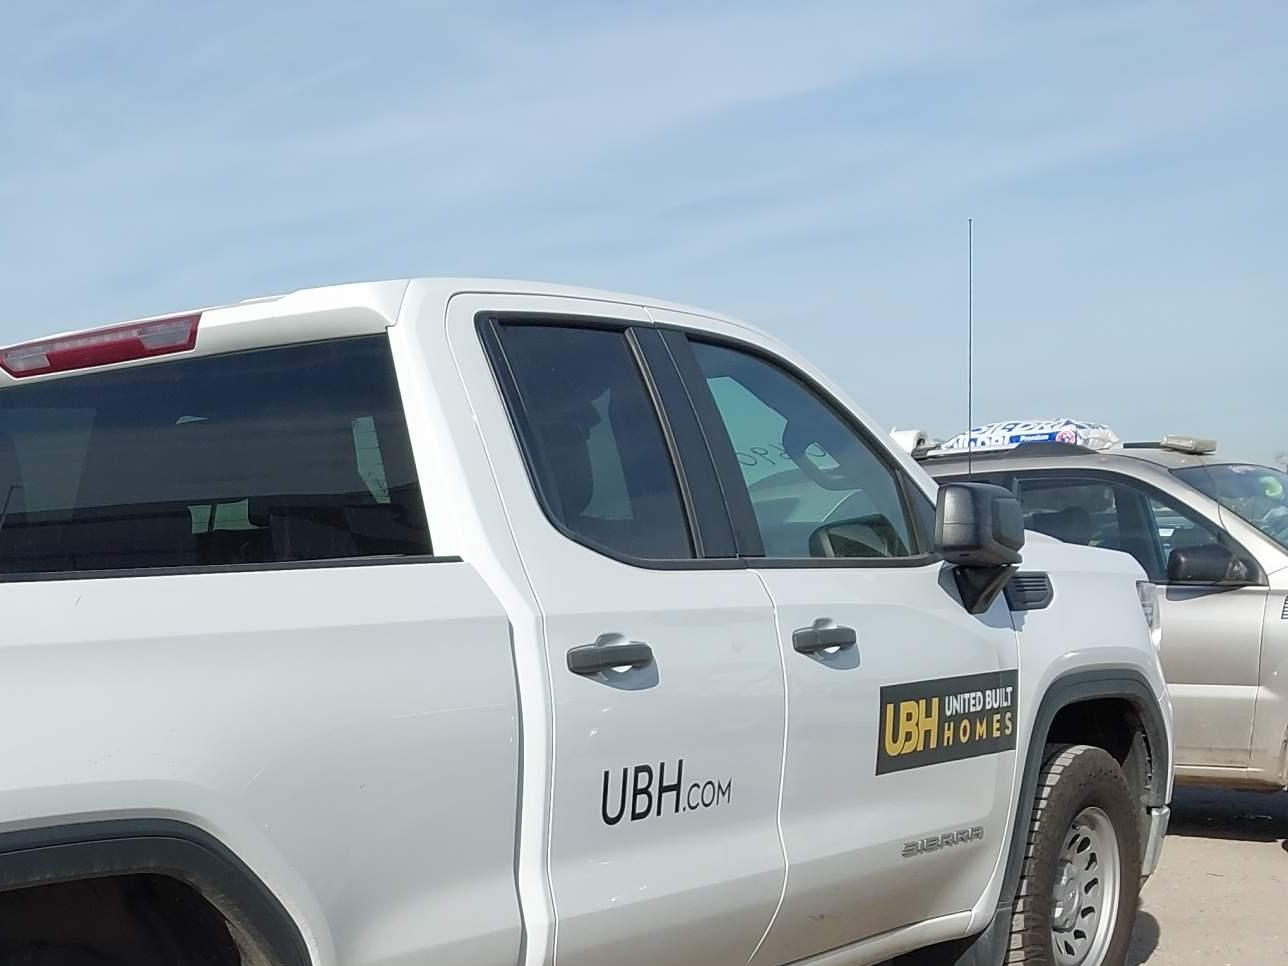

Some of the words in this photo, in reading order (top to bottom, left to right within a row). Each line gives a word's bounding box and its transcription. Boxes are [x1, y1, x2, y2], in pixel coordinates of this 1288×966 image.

[944, 691, 984, 717] UNITED
[985, 685, 1014, 709] BUILT
[883, 696, 939, 758] UBH
[943, 713, 1014, 747] HOMES
[601, 758, 732, 826] UBH.COM
[901, 825, 984, 858] SIERRA
